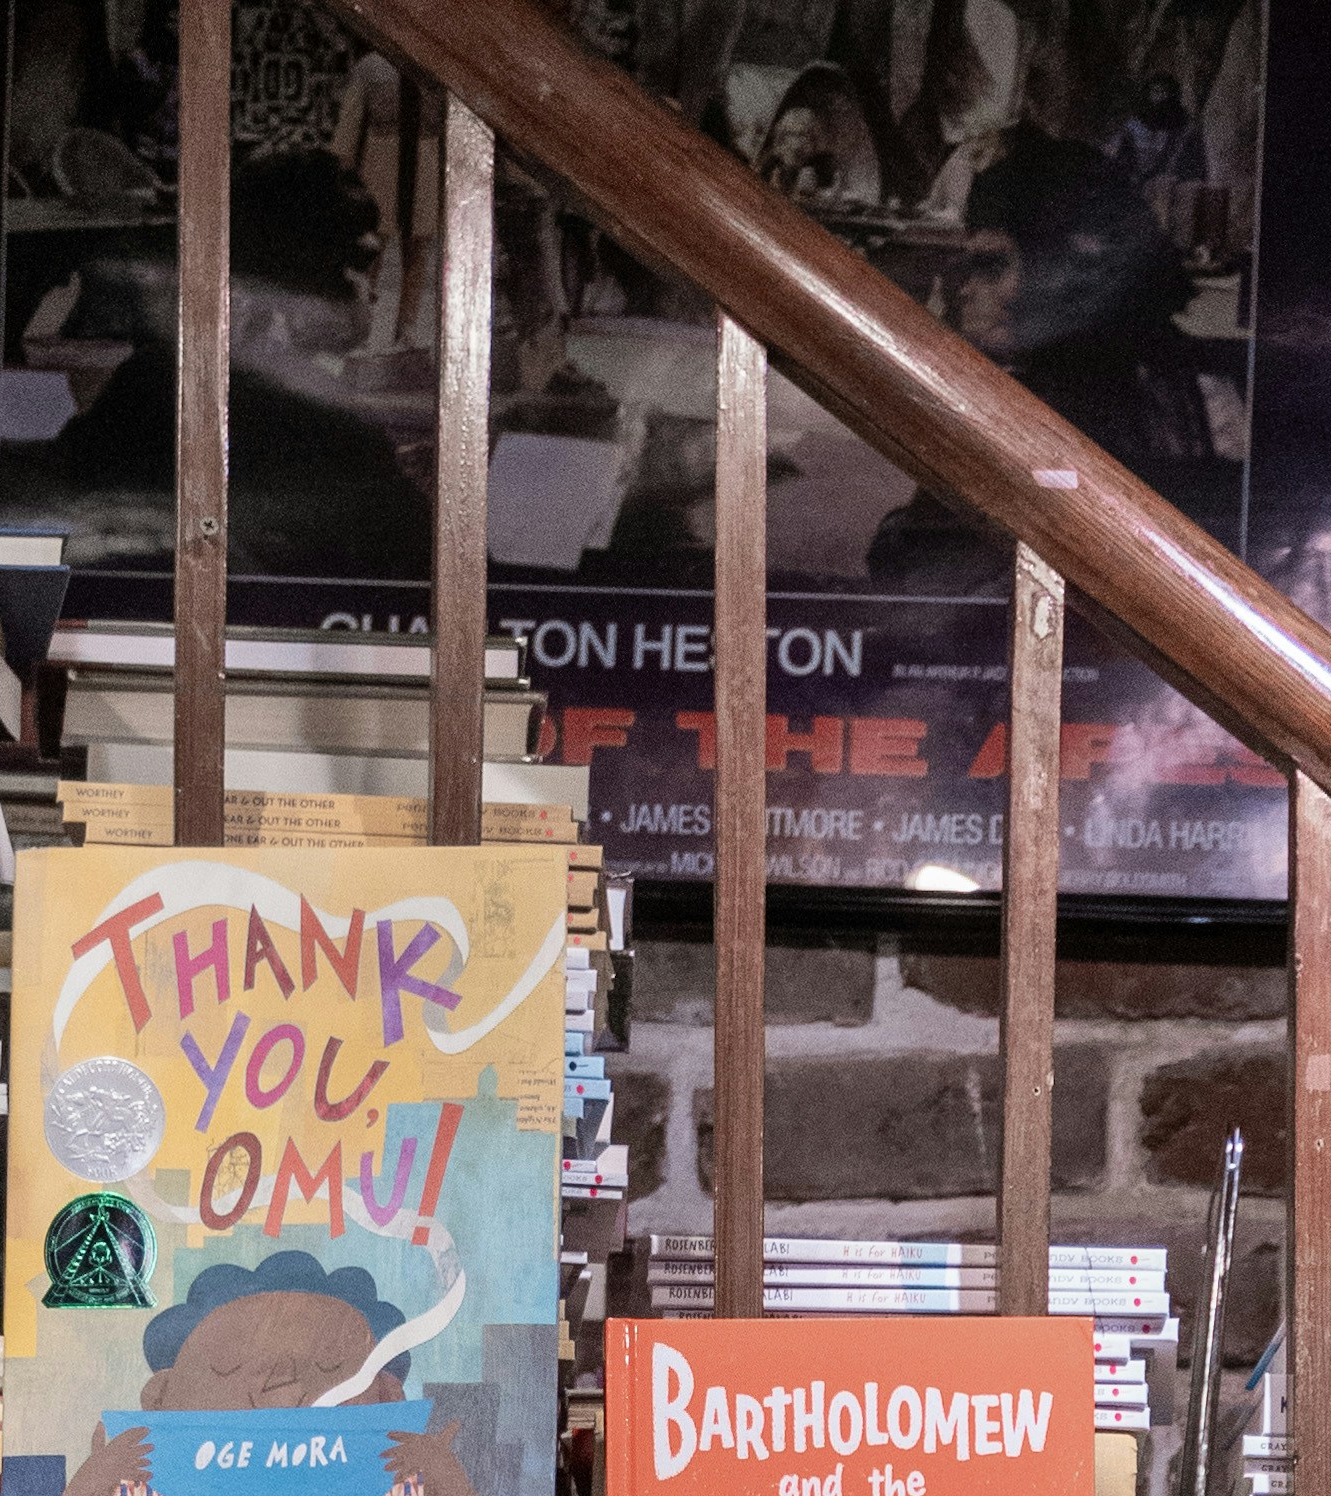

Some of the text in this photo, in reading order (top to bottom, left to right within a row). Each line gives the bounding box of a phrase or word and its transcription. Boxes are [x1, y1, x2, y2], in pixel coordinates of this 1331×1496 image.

[71, 891, 463, 1047] THANK
[179, 1011, 388, 1133] YOU,
[199, 1102, 463, 1247] OMU!
[194, 1436, 347, 1470] OGE MORA
[651, 1341, 1053, 1480] BARTHOLOMEW
